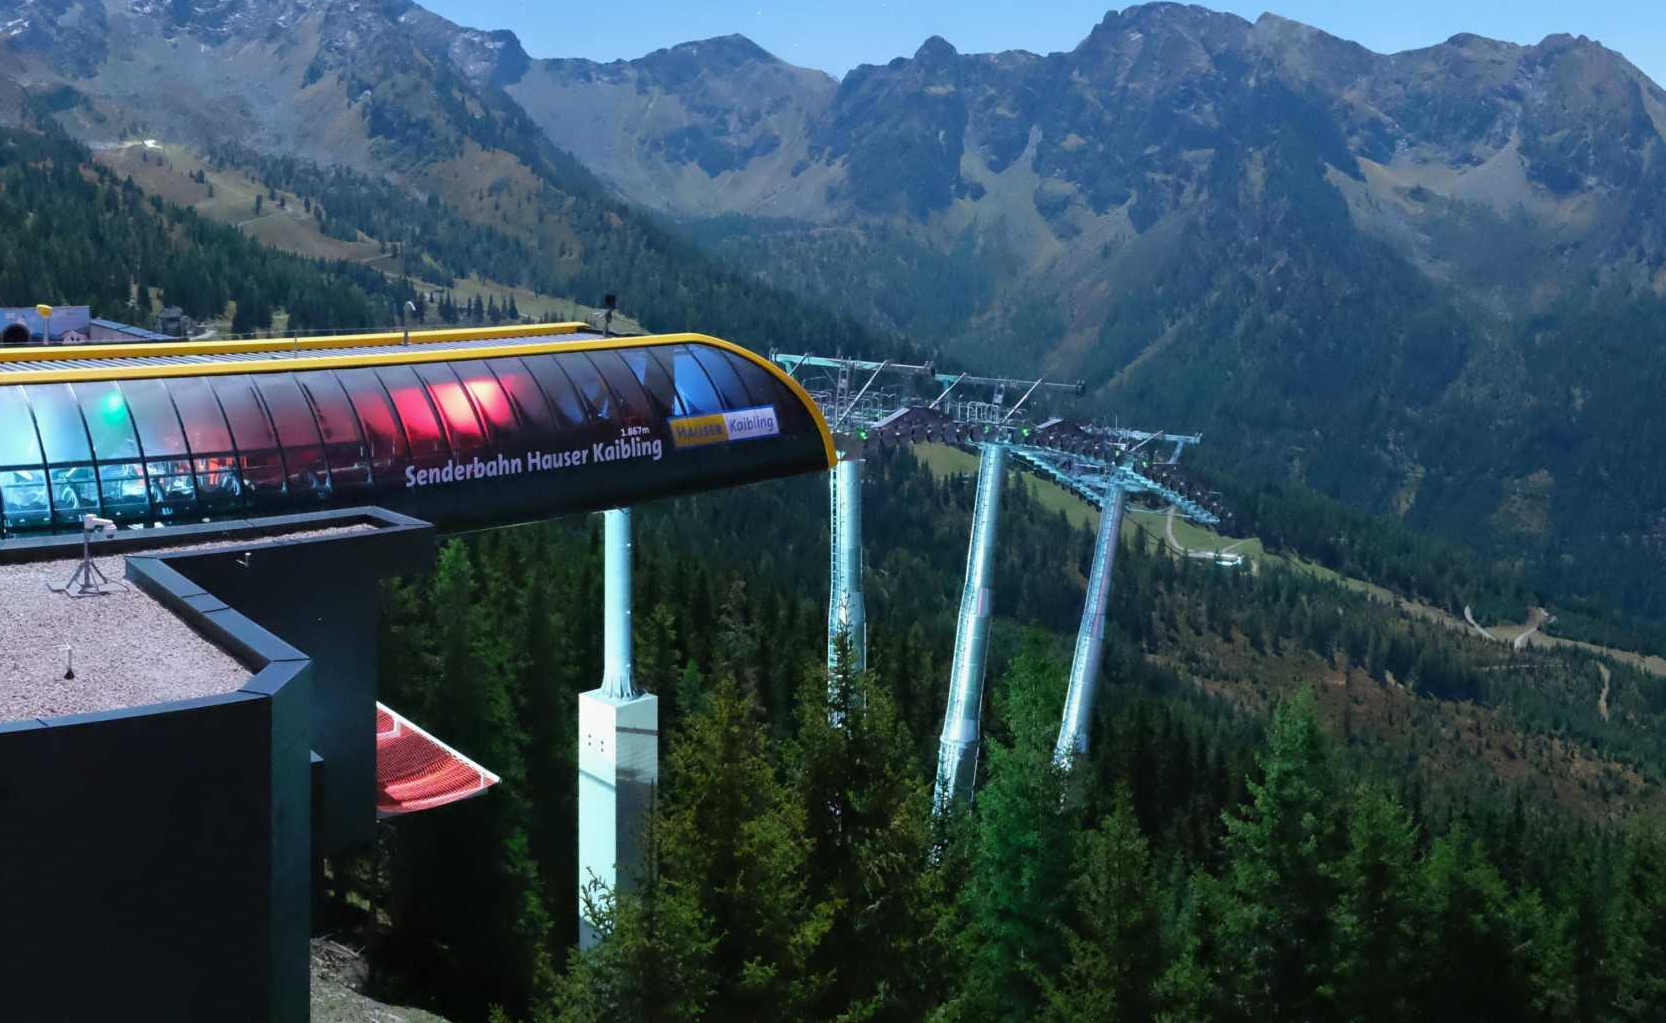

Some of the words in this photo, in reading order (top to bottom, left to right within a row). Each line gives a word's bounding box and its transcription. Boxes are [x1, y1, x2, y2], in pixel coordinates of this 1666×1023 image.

[620, 426, 650, 437] 1.867m
[676, 424, 723, 439] HAUSER
[729, 415, 774, 432] Kaibling
[405, 453, 522, 488] Senderbahn
[527, 447, 589, 472] Hauser
[593, 437, 662, 463] Kaibling
